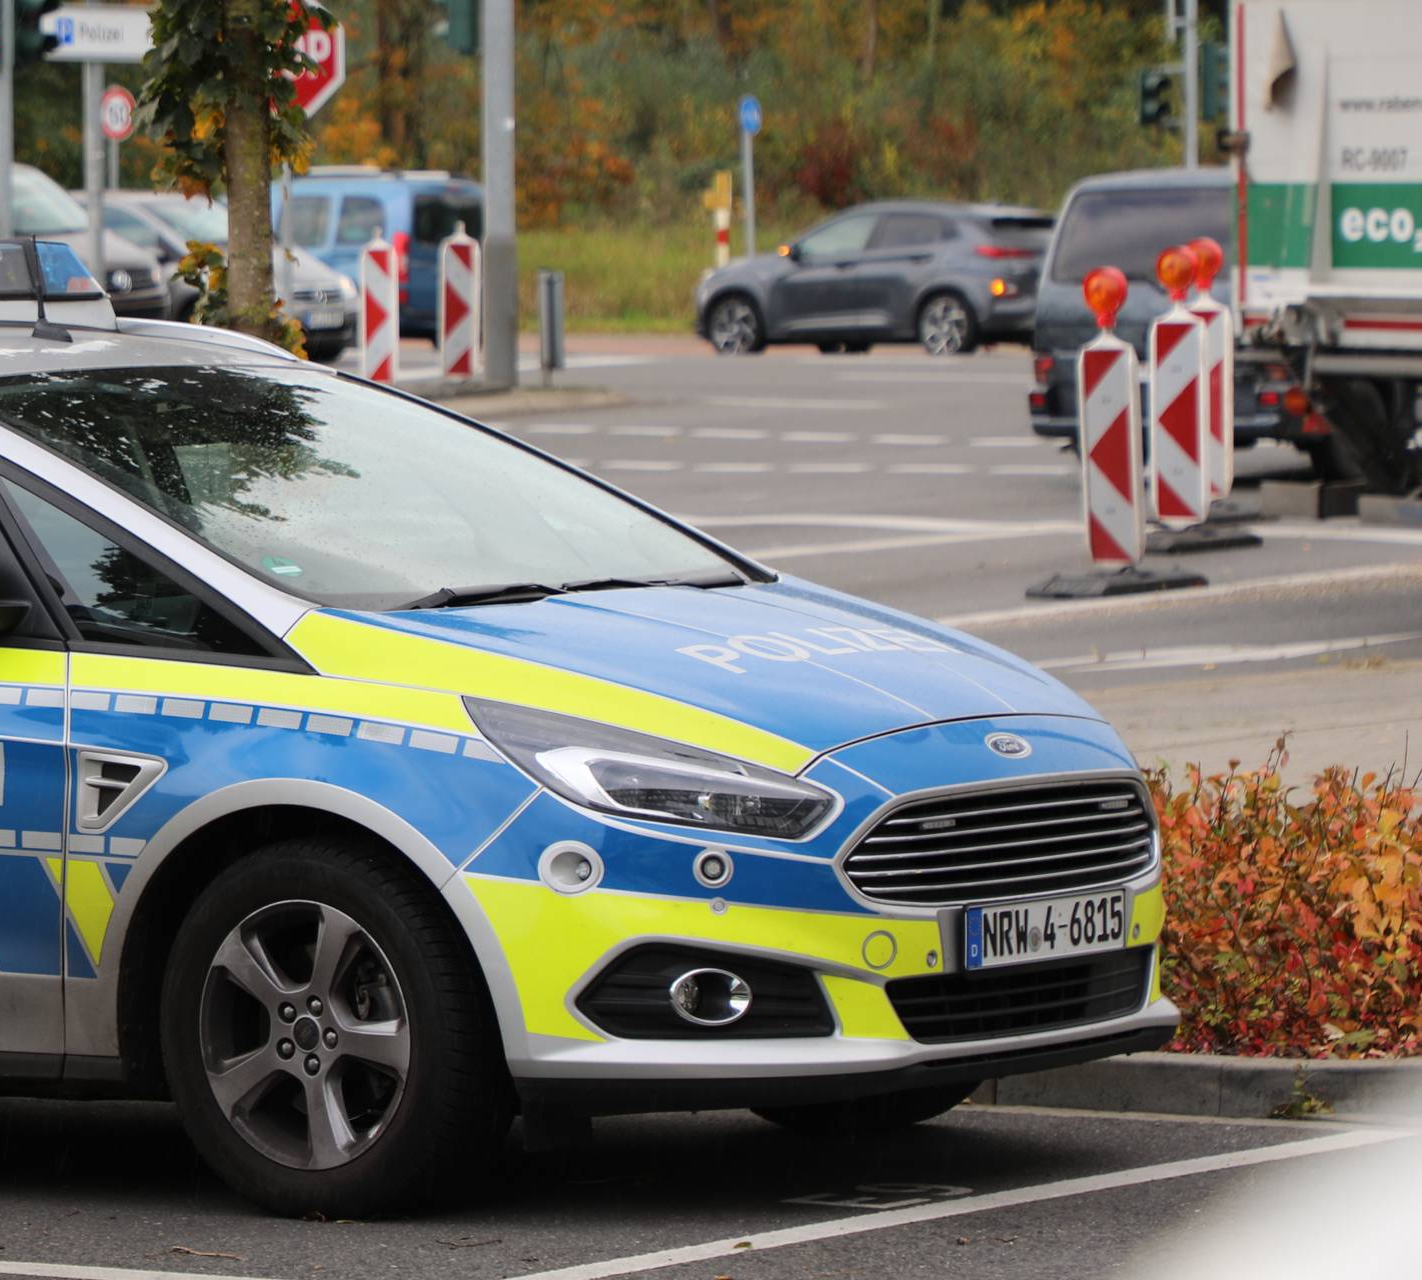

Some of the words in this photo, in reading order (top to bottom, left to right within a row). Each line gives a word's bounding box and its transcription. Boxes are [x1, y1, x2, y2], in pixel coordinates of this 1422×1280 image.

[81, 23, 124, 41] Polizei
[674, 627, 964, 674] POLIZEI
[983, 908, 1029, 958] NRW
[1043, 895, 1123, 950] 4-6815
[971, 944, 978, 958] D
